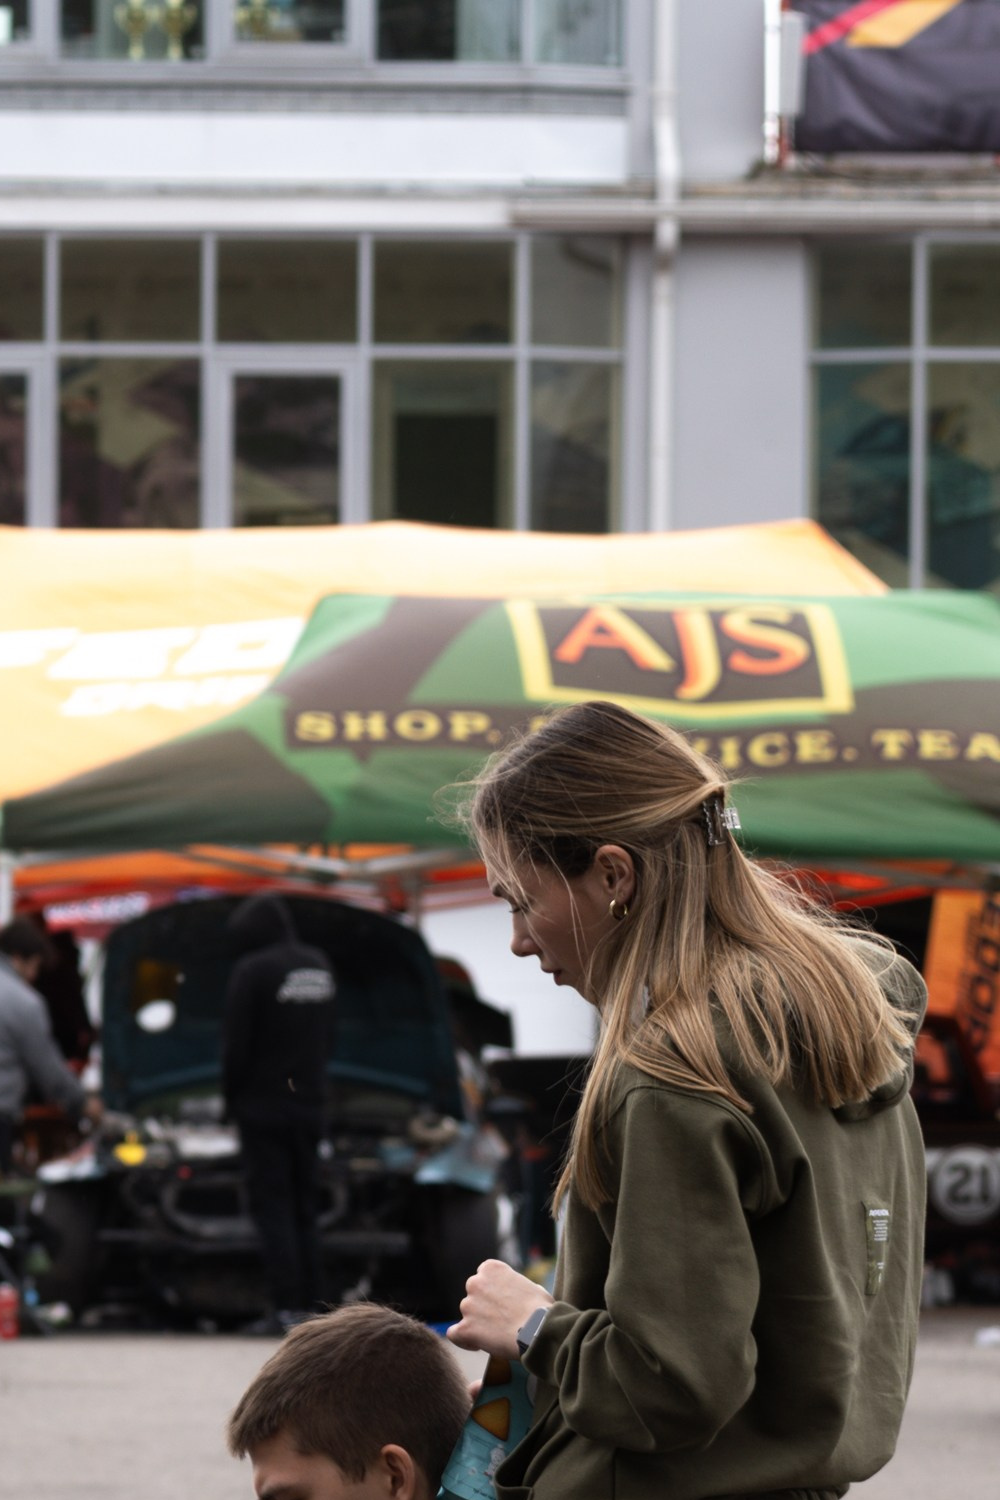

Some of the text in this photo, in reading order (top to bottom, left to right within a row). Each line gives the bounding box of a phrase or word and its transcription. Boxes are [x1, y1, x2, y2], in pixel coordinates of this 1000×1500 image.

[555, 604, 810, 700] AJS
[295, 709, 501, 744] SHOP.
[947, 1162, 991, 1204] 21
